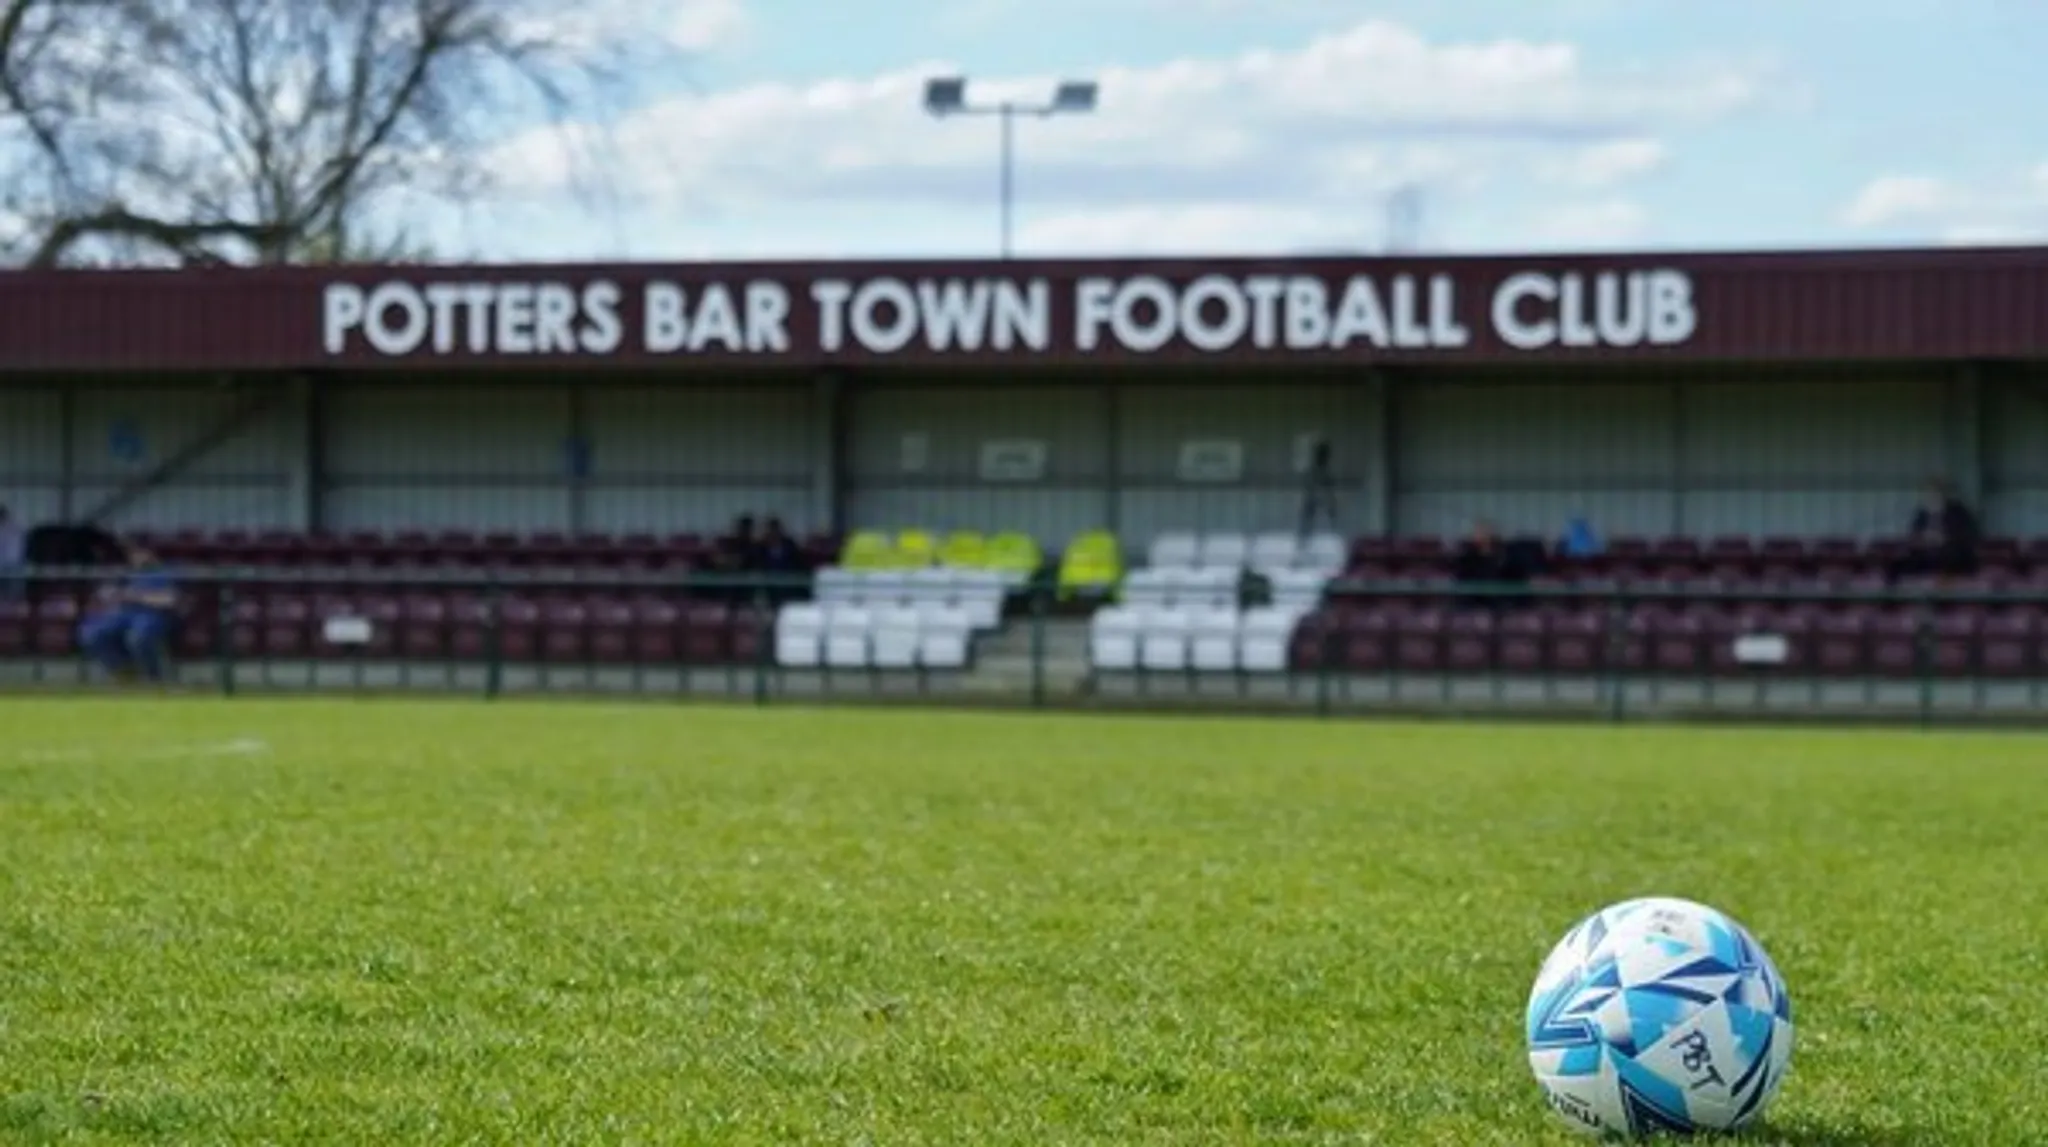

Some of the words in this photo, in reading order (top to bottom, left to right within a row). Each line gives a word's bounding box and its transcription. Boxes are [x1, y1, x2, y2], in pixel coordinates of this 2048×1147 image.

[324, 282, 622, 354] POTTERS
[645, 282, 789, 353] BAR
[812, 279, 1049, 353] TOWN
[1076, 276, 1468, 352] FOOTBALL
[1492, 272, 1696, 348] CLUB
[1669, 1029, 1726, 1090] PBT
